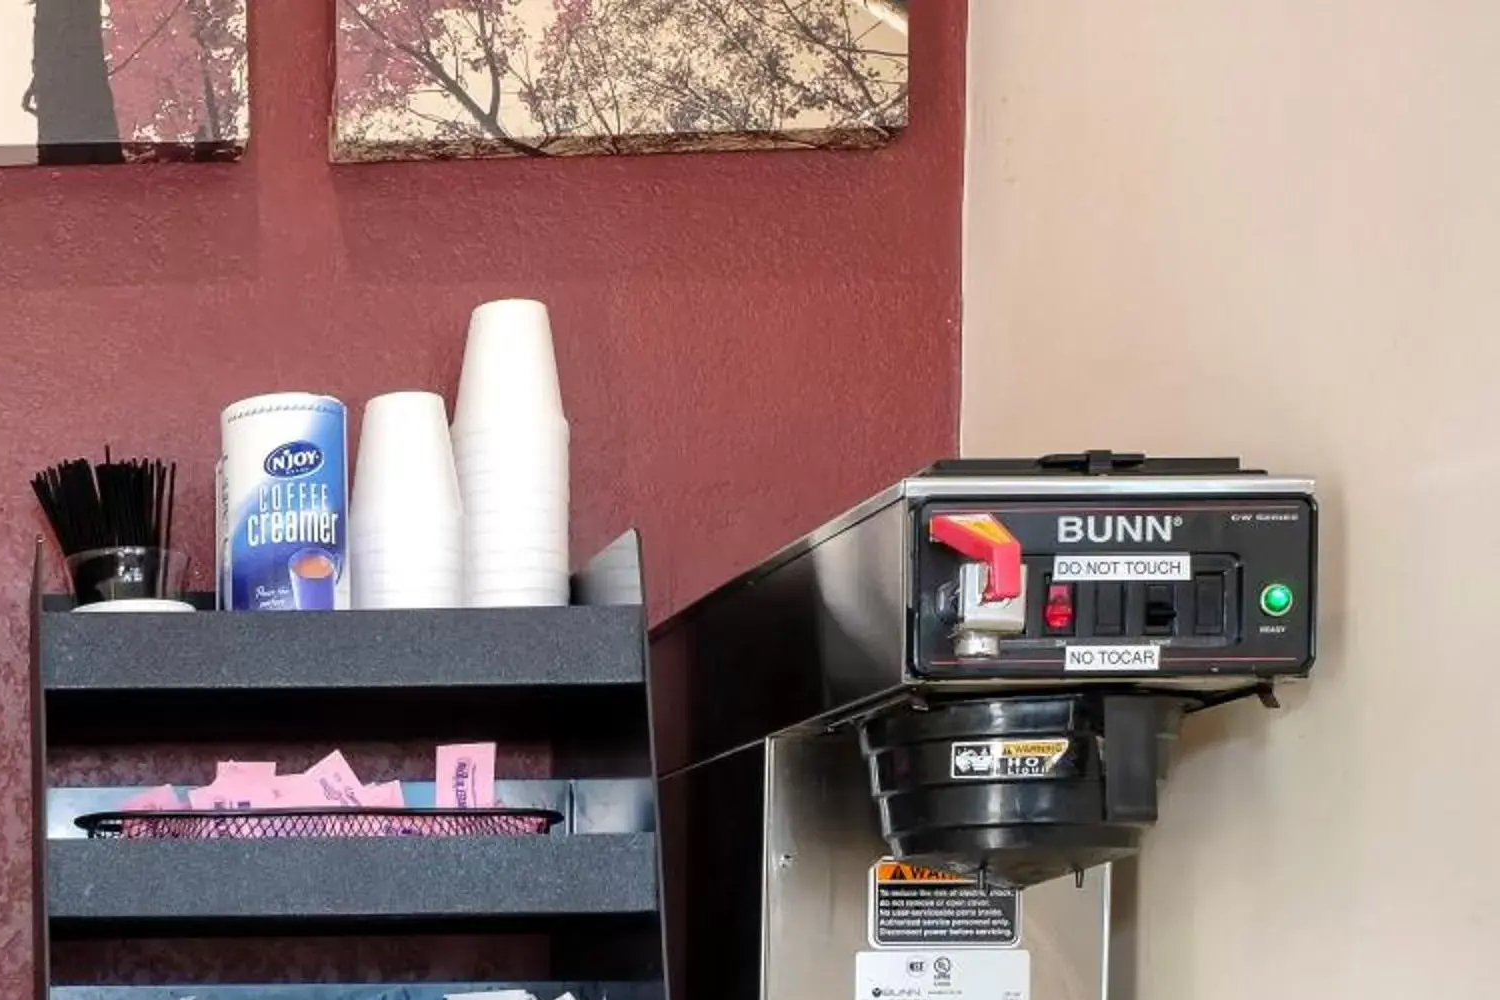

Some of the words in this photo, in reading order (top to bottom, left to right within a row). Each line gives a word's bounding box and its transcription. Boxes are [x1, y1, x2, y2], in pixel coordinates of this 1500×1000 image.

[260, 482, 328, 513] COFFEE
[248, 510, 339, 546] creamer
[1057, 561, 1082, 575] DO
[1087, 561, 1120, 575] NOT
[1124, 561, 1181, 575] TOUCH
[1070, 650, 1095, 665] NO
[1098, 650, 1155, 665] TOCAR
